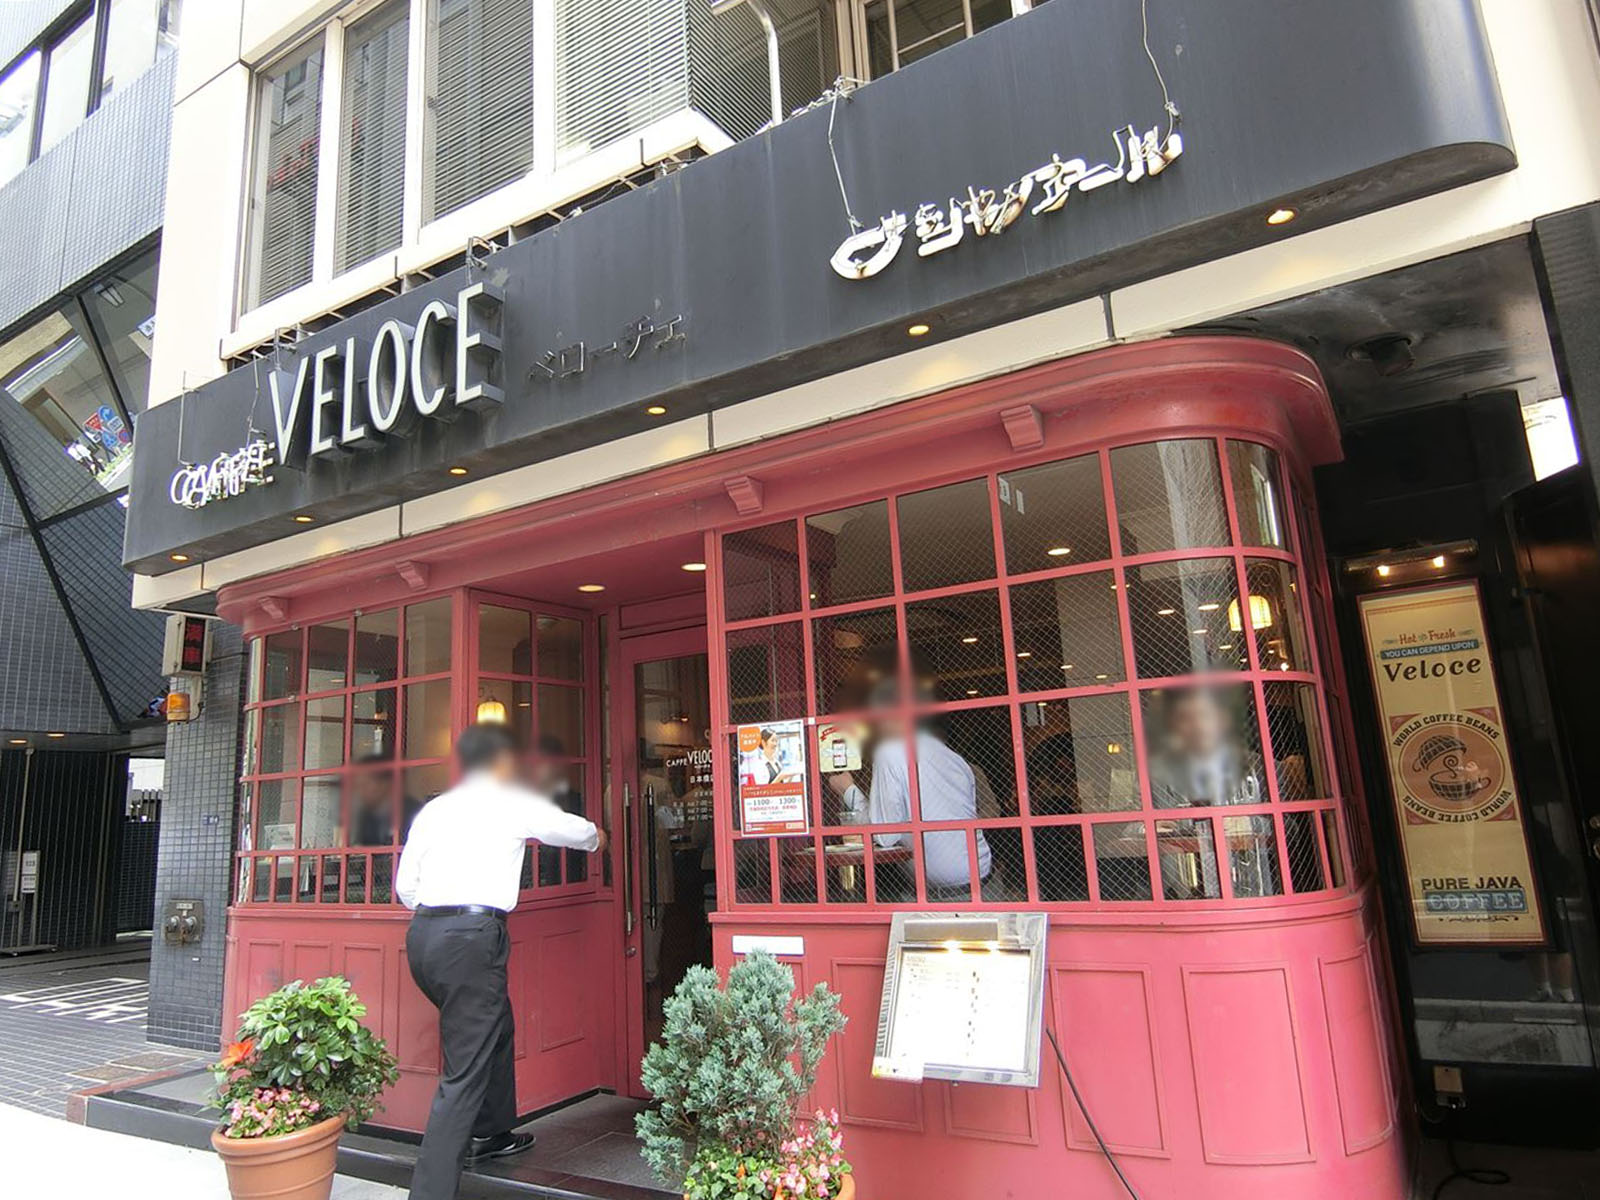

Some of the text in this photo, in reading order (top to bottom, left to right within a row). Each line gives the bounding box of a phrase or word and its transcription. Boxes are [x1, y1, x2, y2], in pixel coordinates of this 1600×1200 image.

[269, 283, 488, 466] VELOCE
[1399, 628, 1456, 645] Hot Fresh
[1401, 648, 1419, 657] CAN
[1419, 644, 1451, 654] DEPEND
[1451, 641, 1475, 651] UPON
[1383, 658, 1481, 682] Veloce
[1393, 713, 1500, 747] WORLD COFFEE BEANS
[1402, 789, 1512, 823] WORLD COFFEE BEANS
[1421, 876, 1522, 890] PURE JAVA
[1427, 892, 1524, 910] COFFEE
